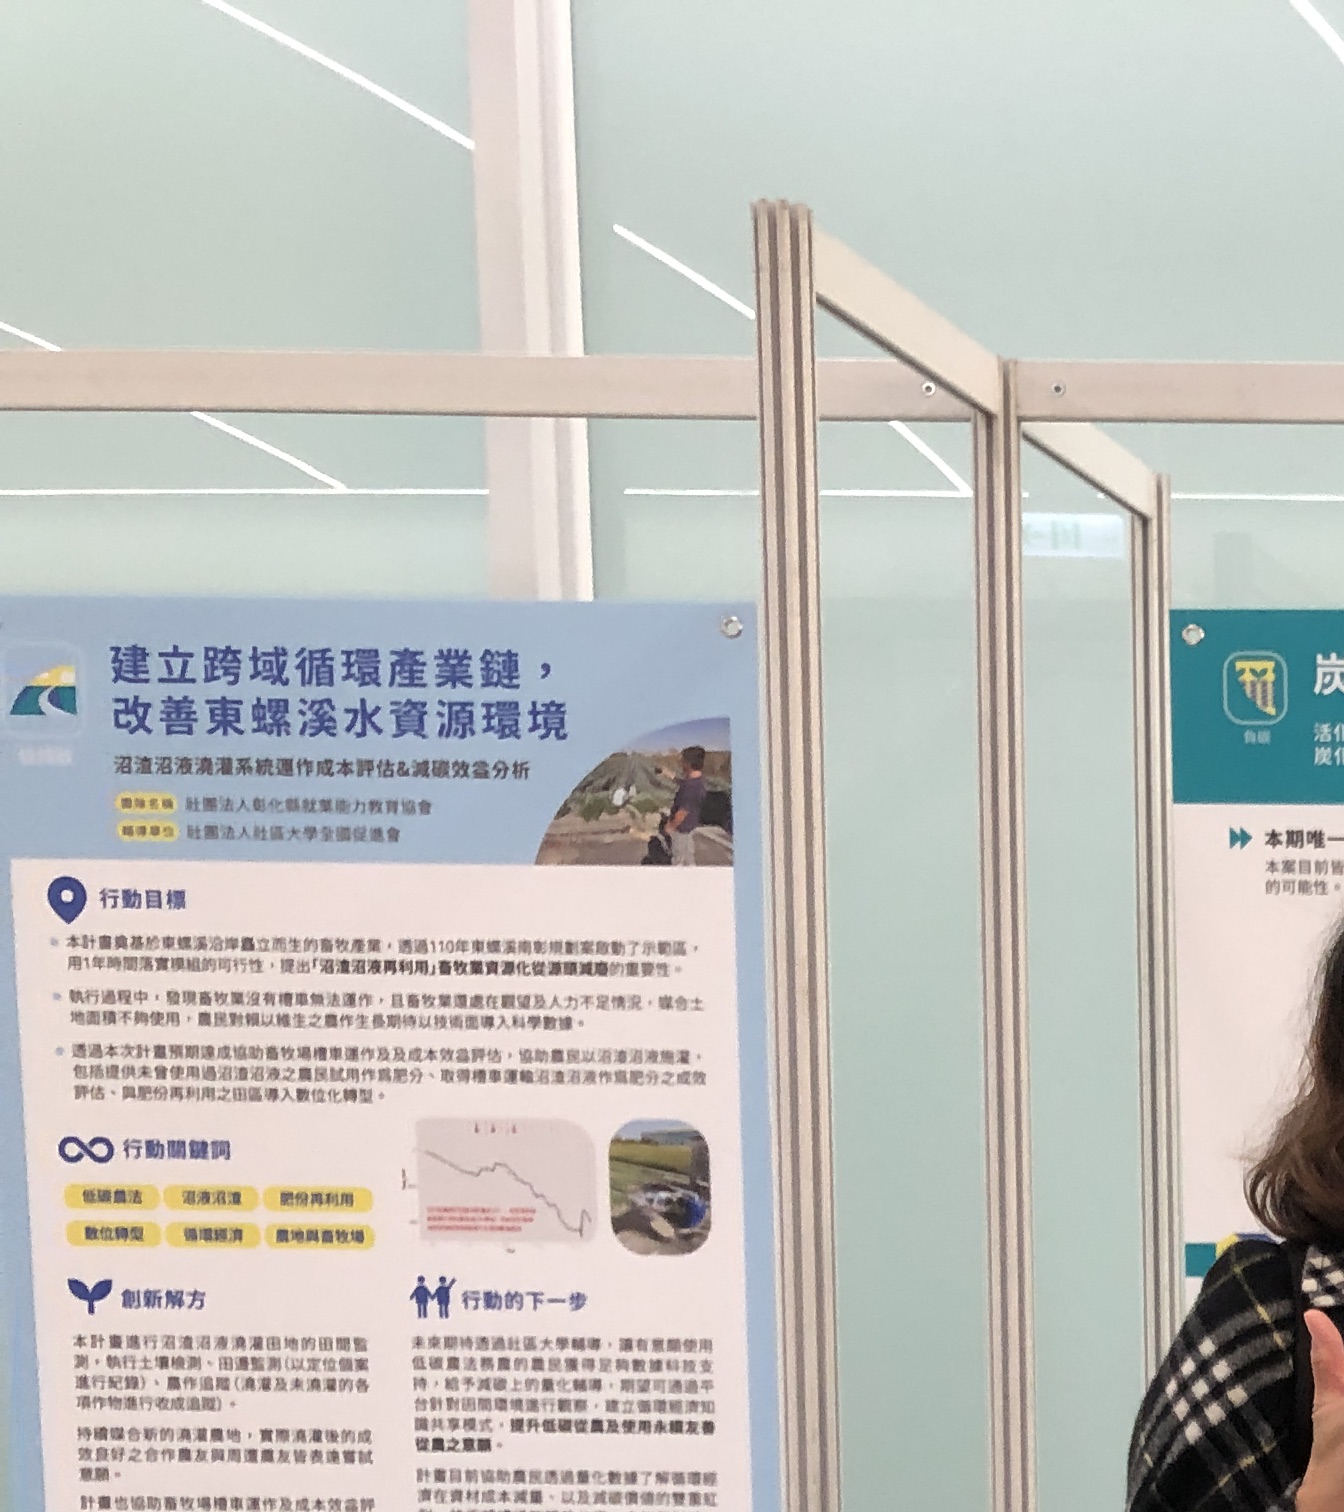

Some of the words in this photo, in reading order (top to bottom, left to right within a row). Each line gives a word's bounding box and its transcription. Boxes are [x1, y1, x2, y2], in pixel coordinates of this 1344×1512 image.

[111, 645, 553, 690] 建立跨域循環產業鏈，
[113, 697, 568, 741] 改善東螺溪水資源環境
[99, 888, 186, 911] 行動目標
[123, 1138, 230, 1162] 行動關鍵詞
[121, 1289, 205, 1311] 創新解方
[462, 1289, 587, 1313] 行動的下一步
